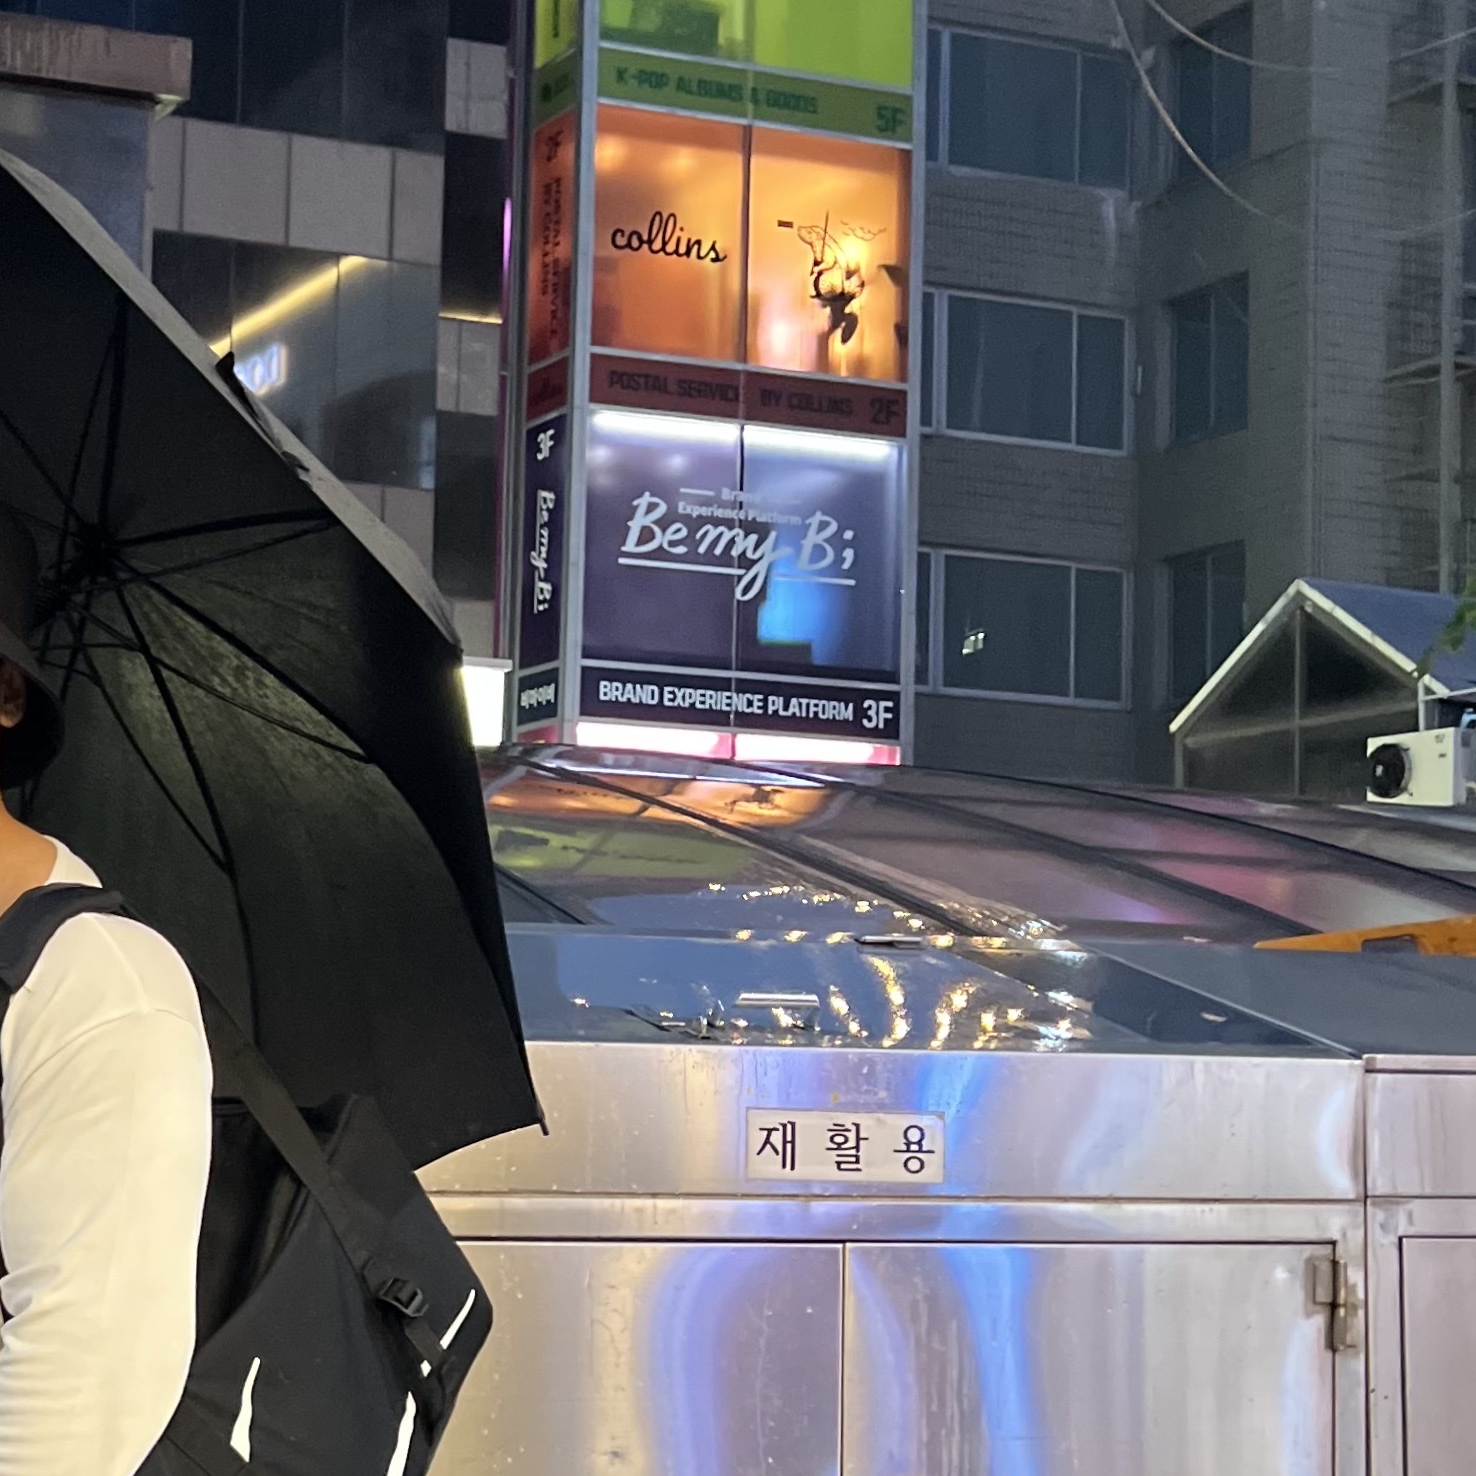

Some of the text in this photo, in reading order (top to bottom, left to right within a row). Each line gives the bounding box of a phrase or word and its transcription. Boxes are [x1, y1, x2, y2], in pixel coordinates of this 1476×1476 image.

[876, 105, 906, 134] 5F
[611, 211, 727, 263] collins
[609, 371, 671, 394] POSTAL
[872, 398, 900, 425] 2F
[536, 428, 555, 460] 3F
[678, 501, 802, 526] Experience Platform
[621, 491, 689, 553] Be
[695, 523, 791, 601] my
[599, 681, 854, 722] BRAND EXPERIENCE PLATFORM
[862, 700, 894, 729] 3F
[756, 1120, 936, 1174] 재활용
